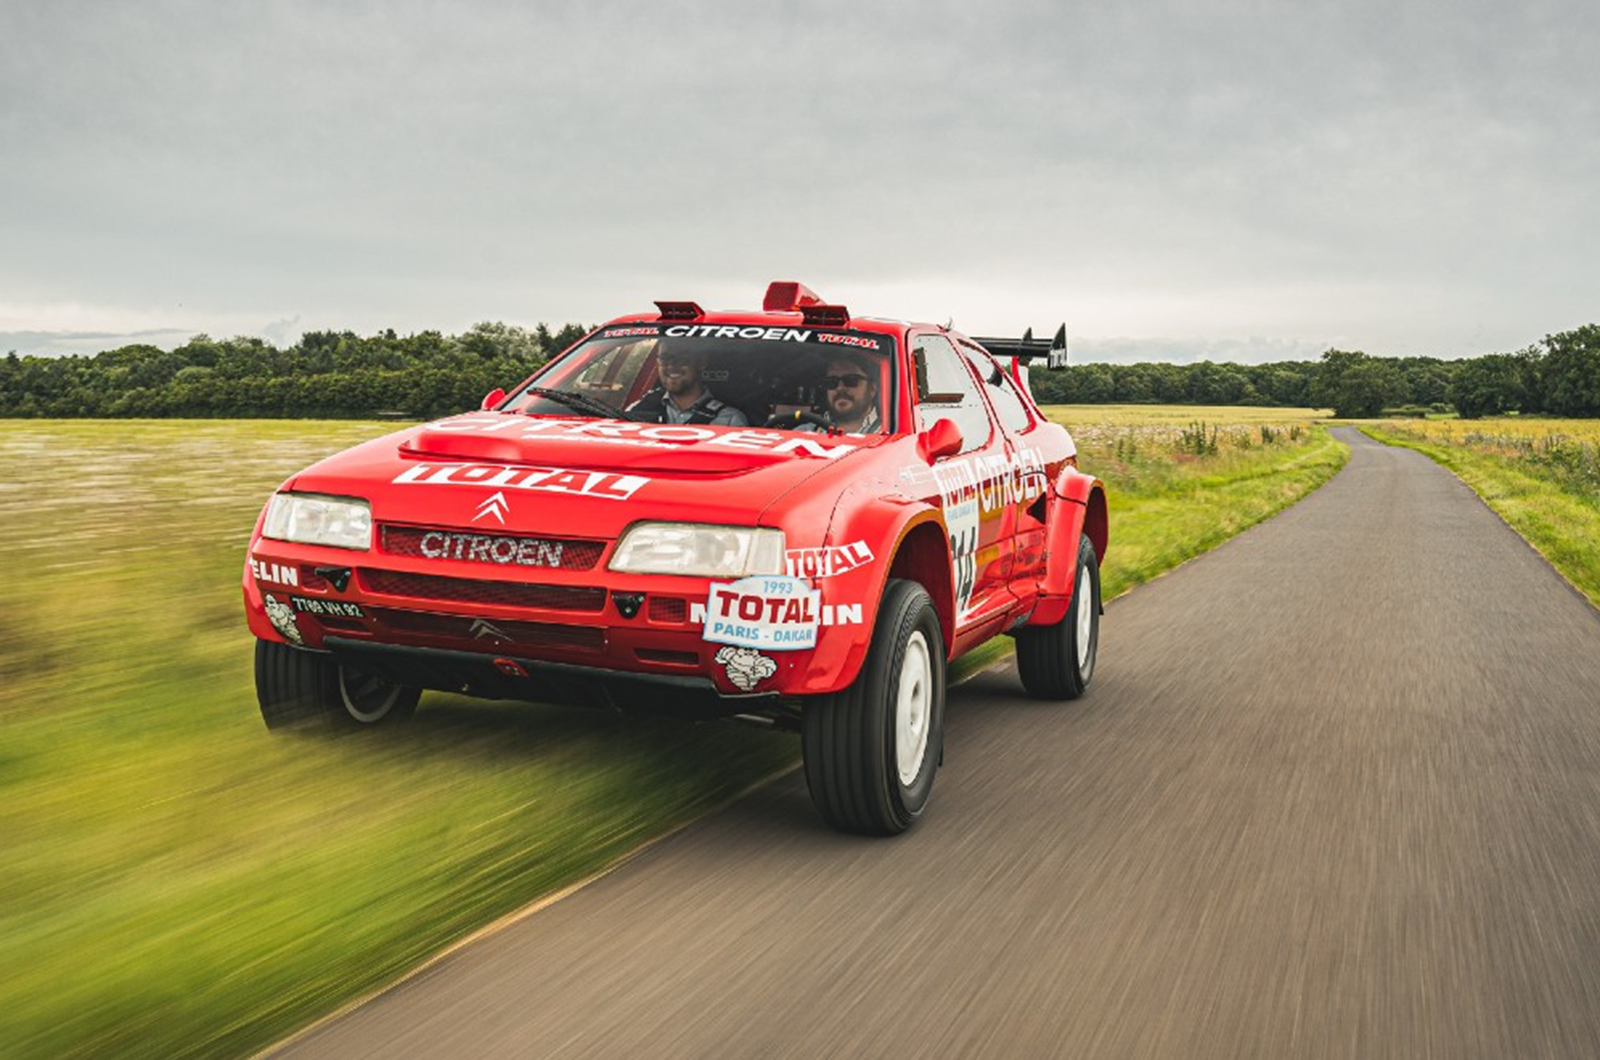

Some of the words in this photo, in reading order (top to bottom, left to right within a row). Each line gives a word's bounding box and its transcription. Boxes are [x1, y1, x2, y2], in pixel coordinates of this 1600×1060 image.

[664, 325, 811, 342] CITROEN
[402, 464, 642, 499] TOTAL
[420, 531, 564, 568] CITROEN
[786, 543, 873, 577] TOTAL
[249, 557, 298, 587] ELIN
[763, 580, 793, 594] 1993
[716, 590, 815, 624] TOTAL
[713, 622, 759, 640] PARIS
[773, 629, 812, 642] DAKAR
